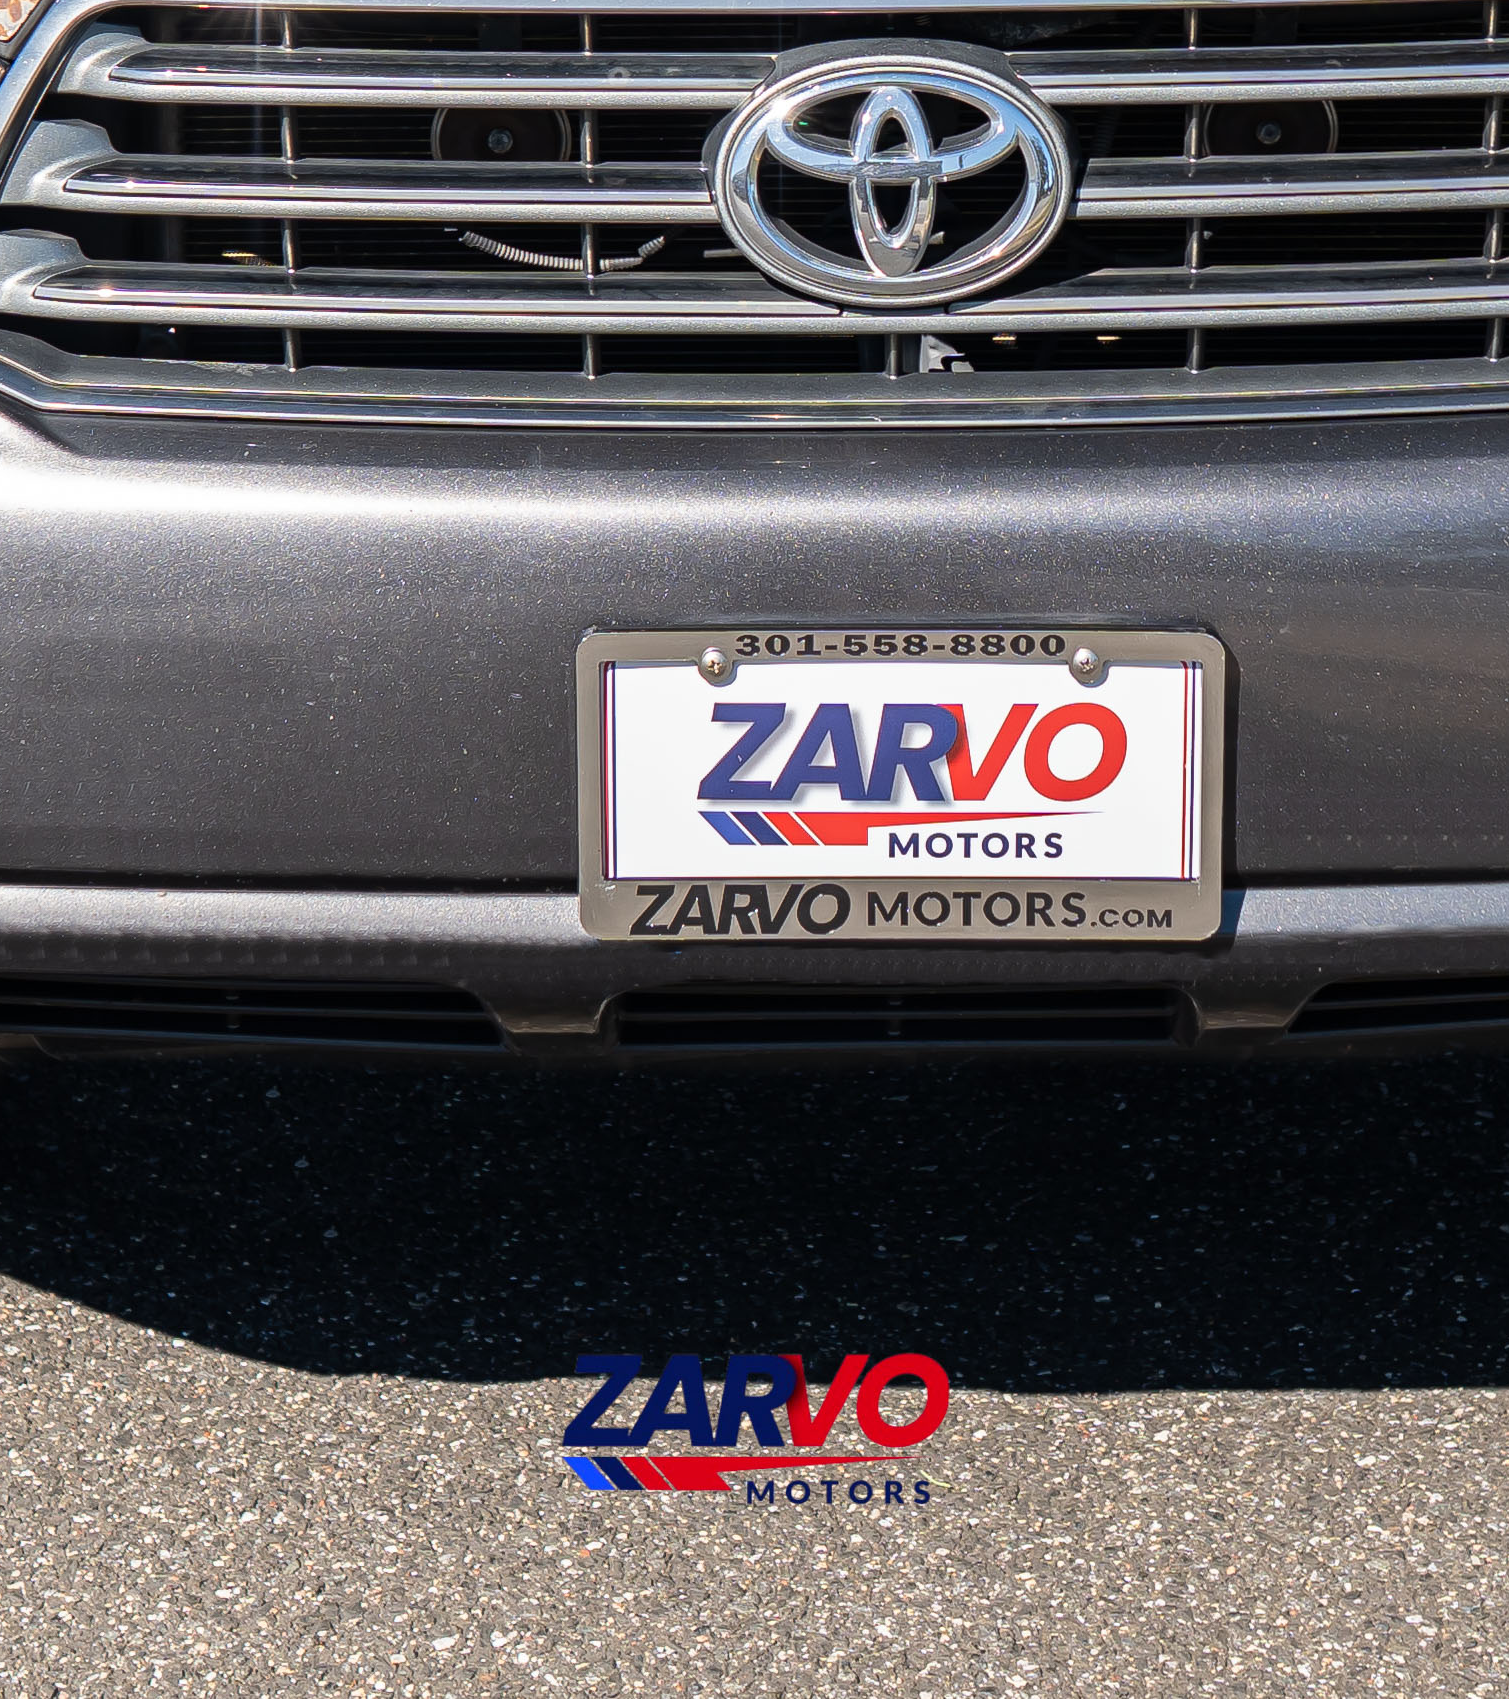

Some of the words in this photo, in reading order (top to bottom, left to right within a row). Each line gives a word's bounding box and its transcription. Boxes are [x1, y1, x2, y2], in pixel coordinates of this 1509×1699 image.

[735, 634, 1067, 657] 301-558-8800
[697, 702, 1128, 802] ZARVO
[888, 832, 1064, 859] MOTORS
[629, 883, 852, 936] ZARVO
